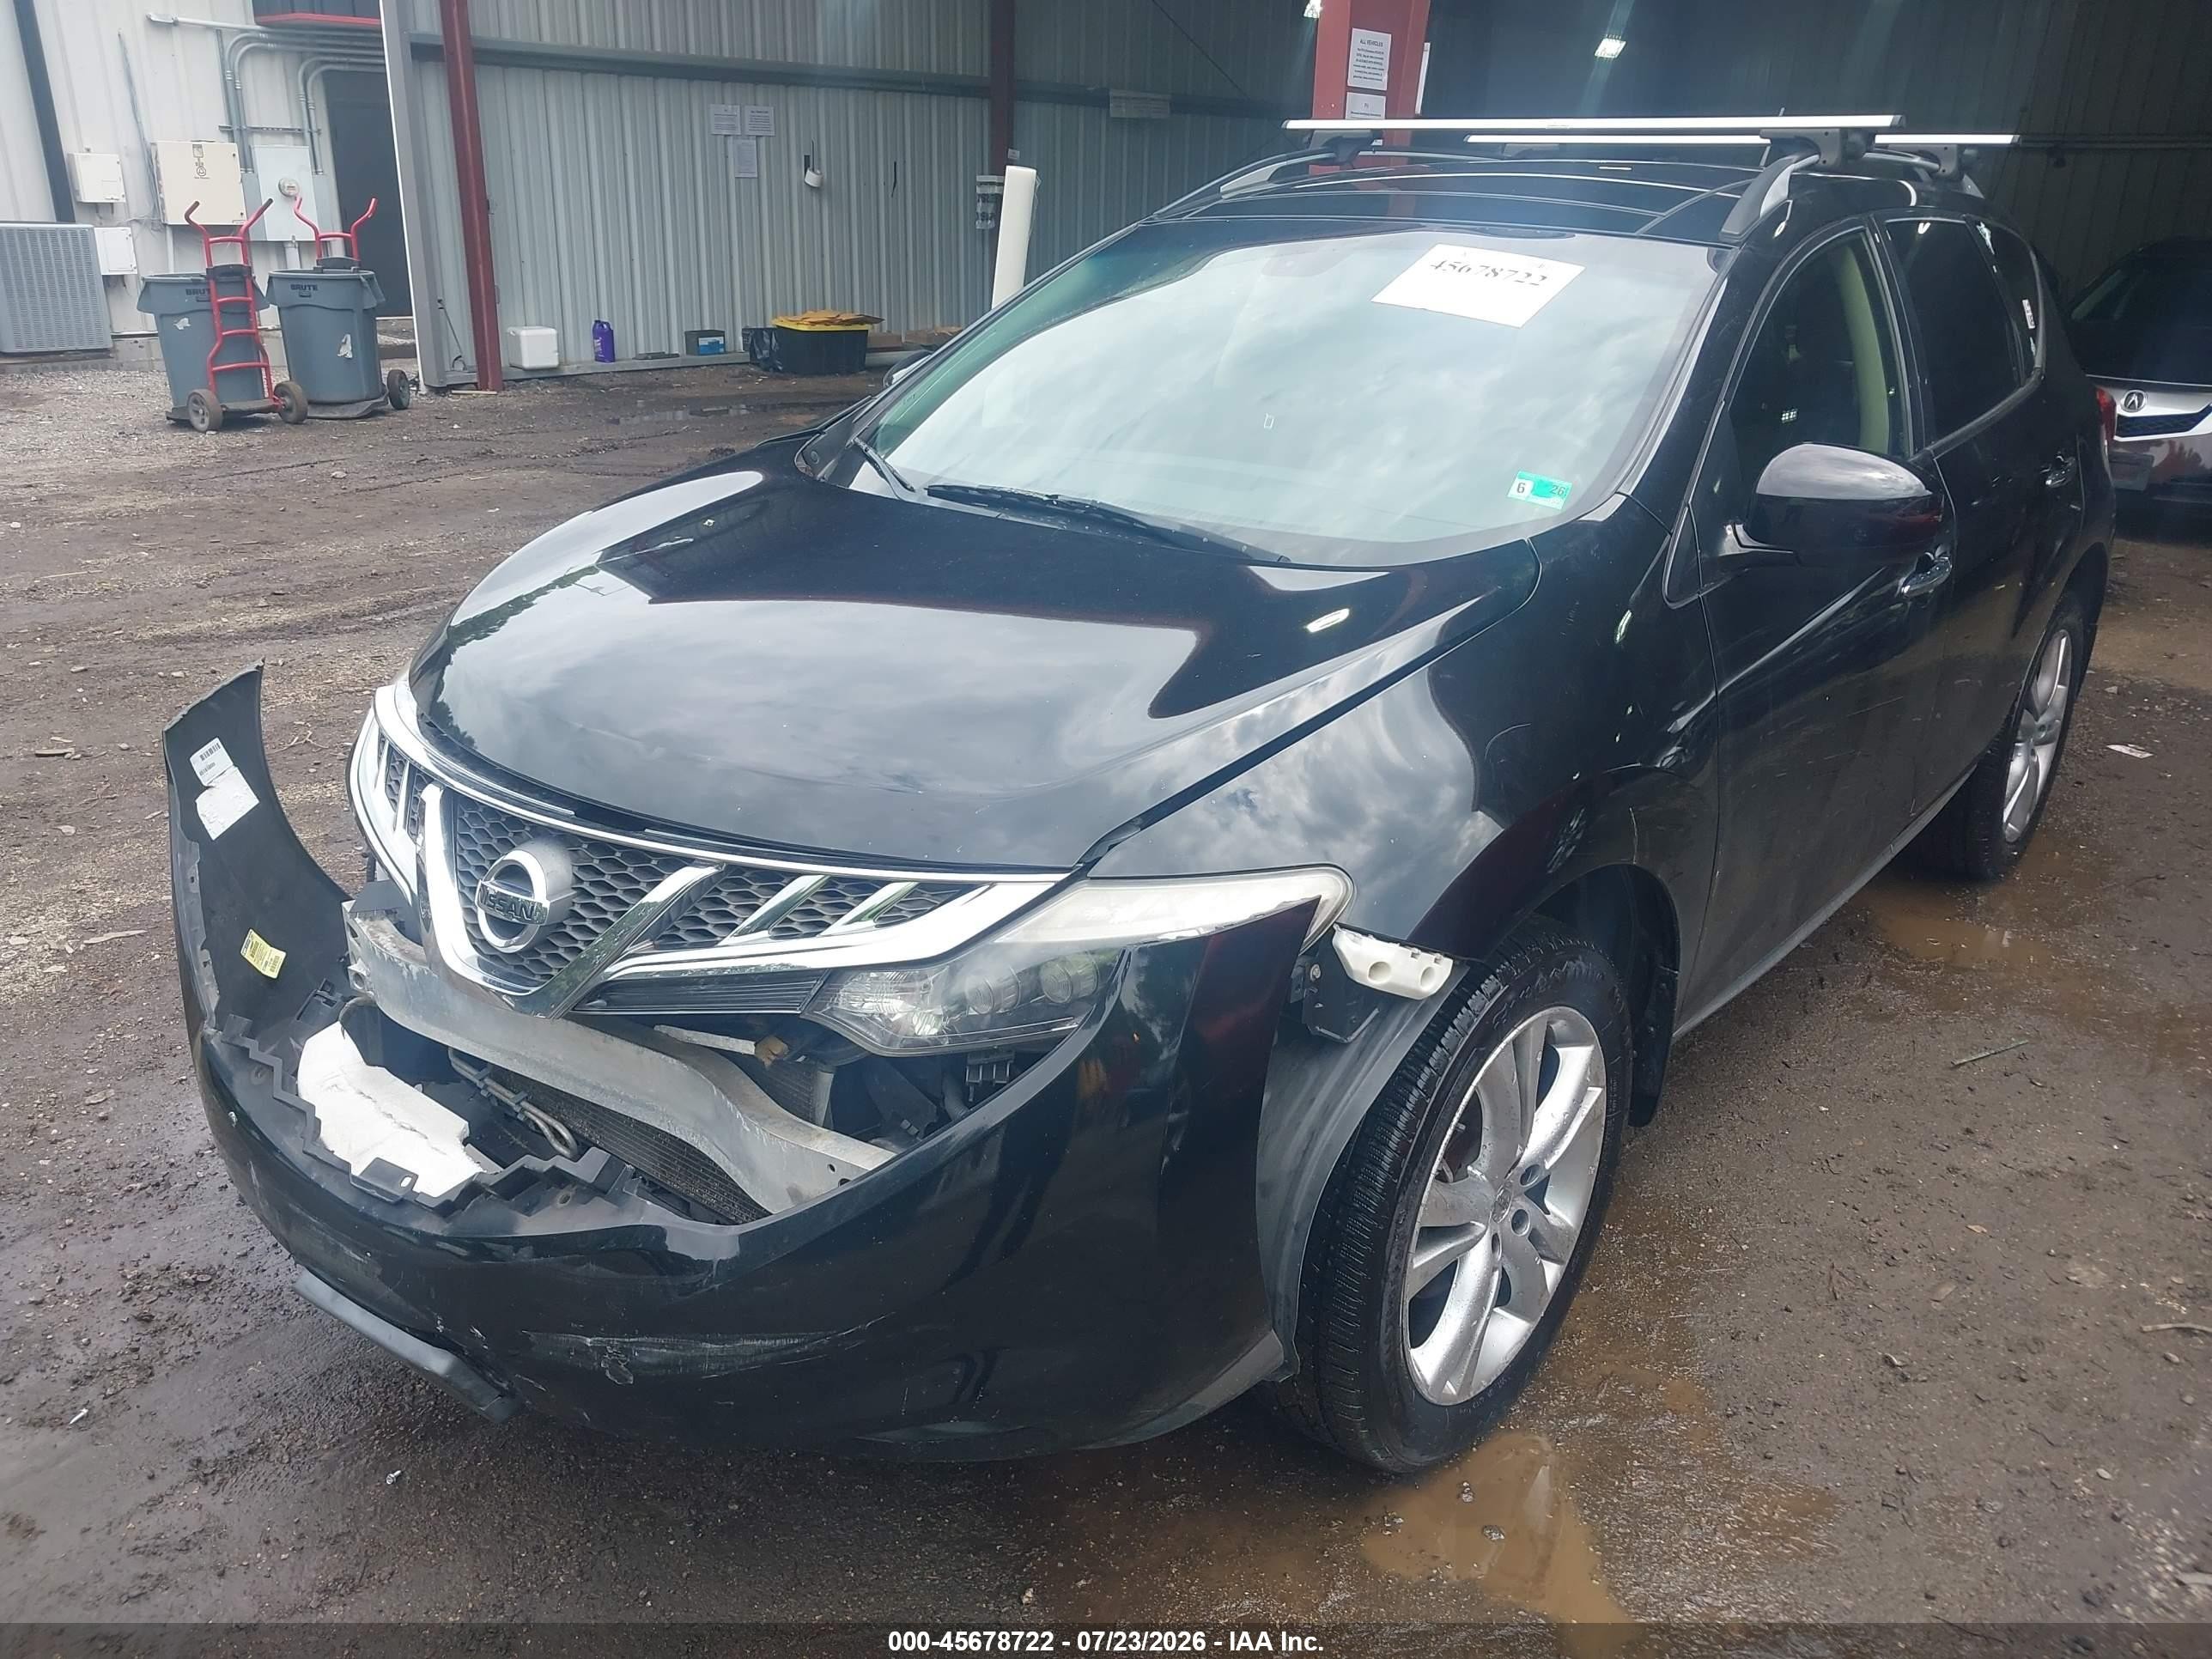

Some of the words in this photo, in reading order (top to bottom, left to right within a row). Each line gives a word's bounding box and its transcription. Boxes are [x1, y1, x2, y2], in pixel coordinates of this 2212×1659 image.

[1431, 260, 1547, 285] 45678722
[1516, 482, 1526, 494] 6
[1549, 484, 1565, 495] 26
[480, 885, 534, 921] NISSAN
